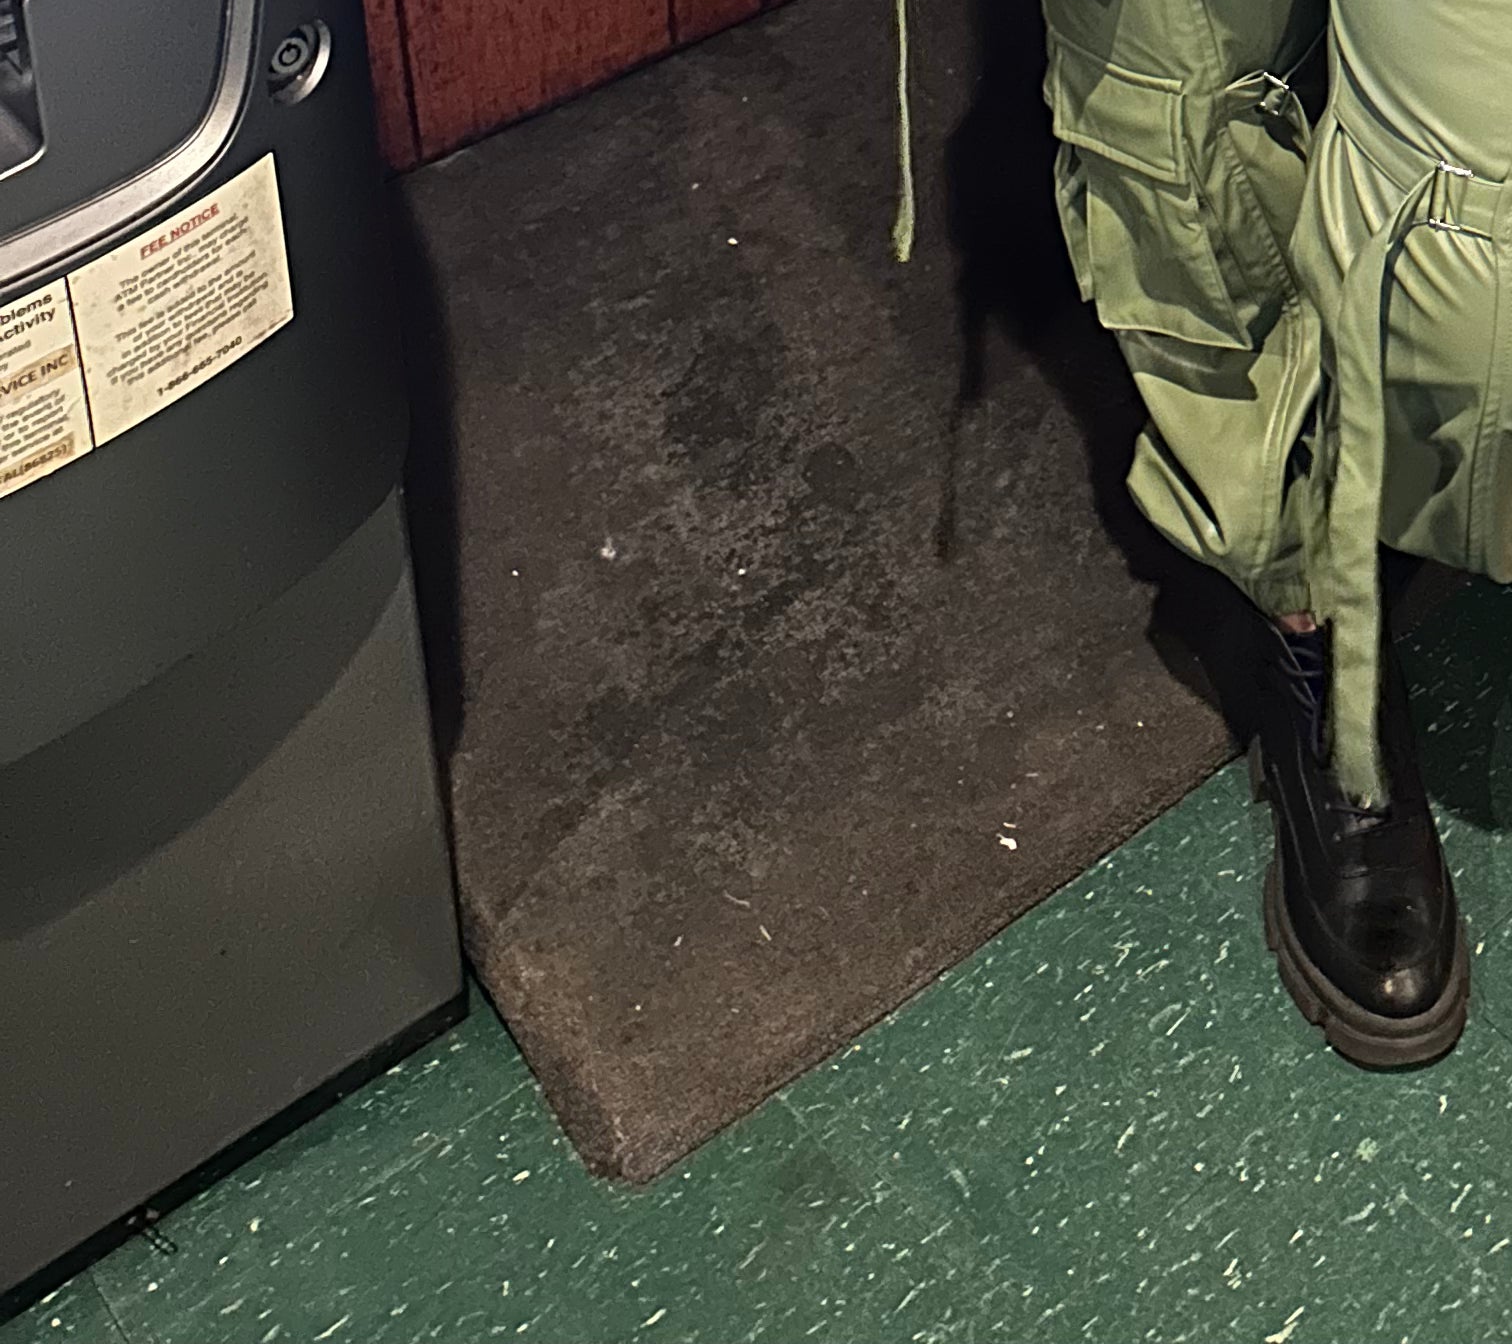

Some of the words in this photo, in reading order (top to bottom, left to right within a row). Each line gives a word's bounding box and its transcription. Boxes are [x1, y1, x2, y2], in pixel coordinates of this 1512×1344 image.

[140, 235, 168, 259] FEE
[170, 203, 219, 241] NOTICE
[0, 370, 37, 397] VICE
[40, 353, 68, 376] INC
